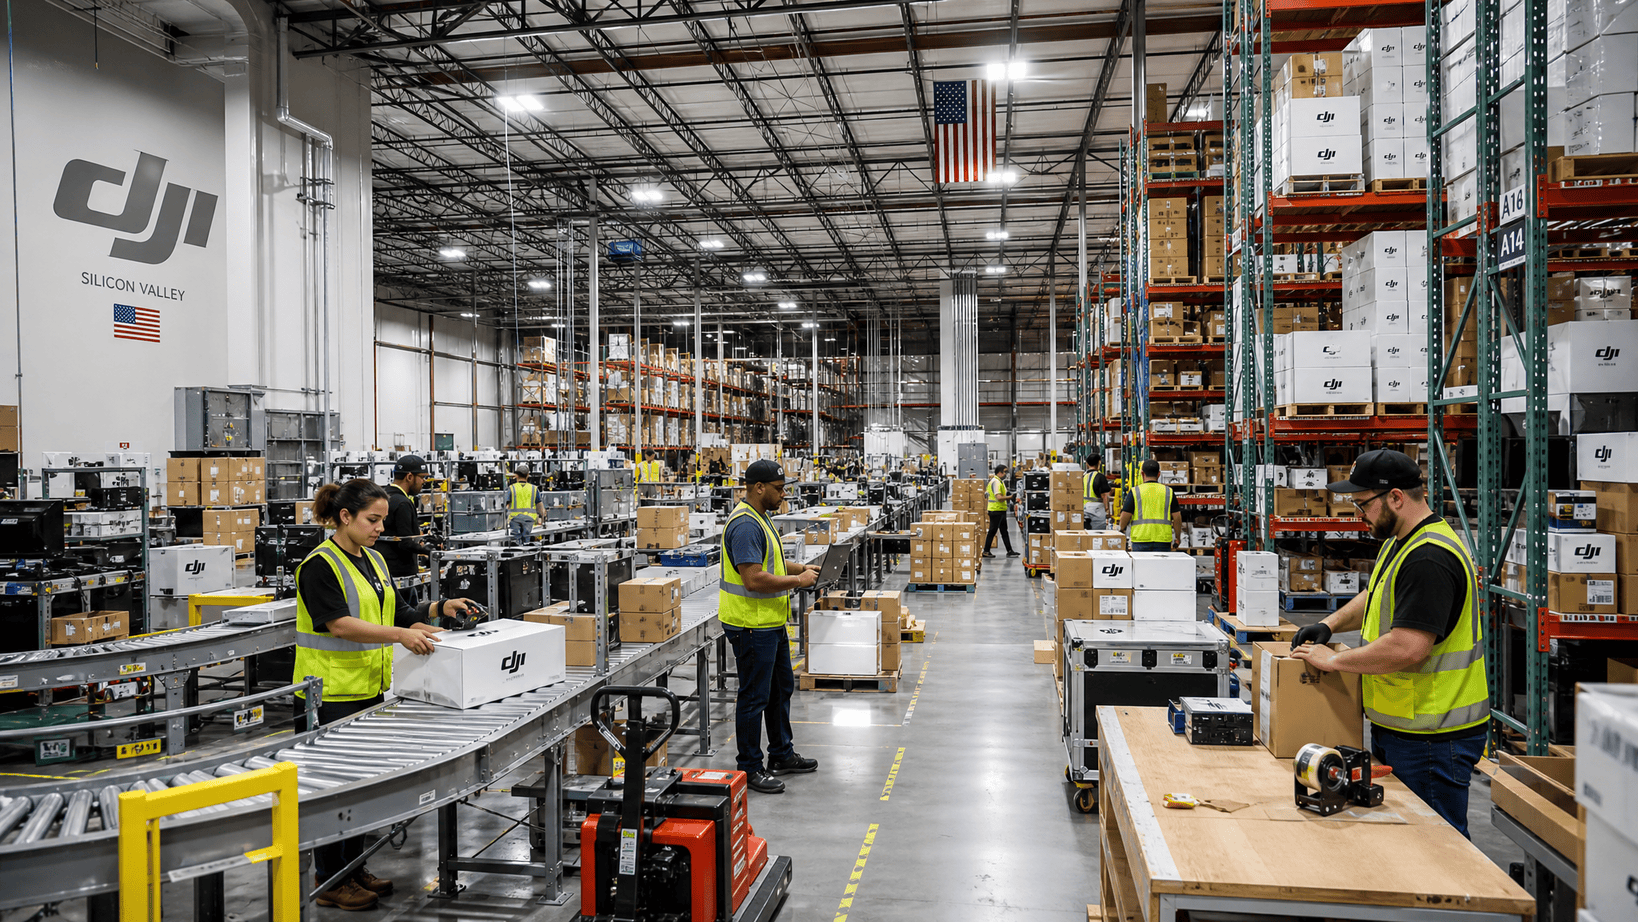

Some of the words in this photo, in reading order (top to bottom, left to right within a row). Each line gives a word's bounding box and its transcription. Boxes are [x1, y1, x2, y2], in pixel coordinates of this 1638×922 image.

[1500, 227, 1525, 257] A14
[81, 271, 135, 293] SILICON
[139, 282, 186, 302] VALLEY
